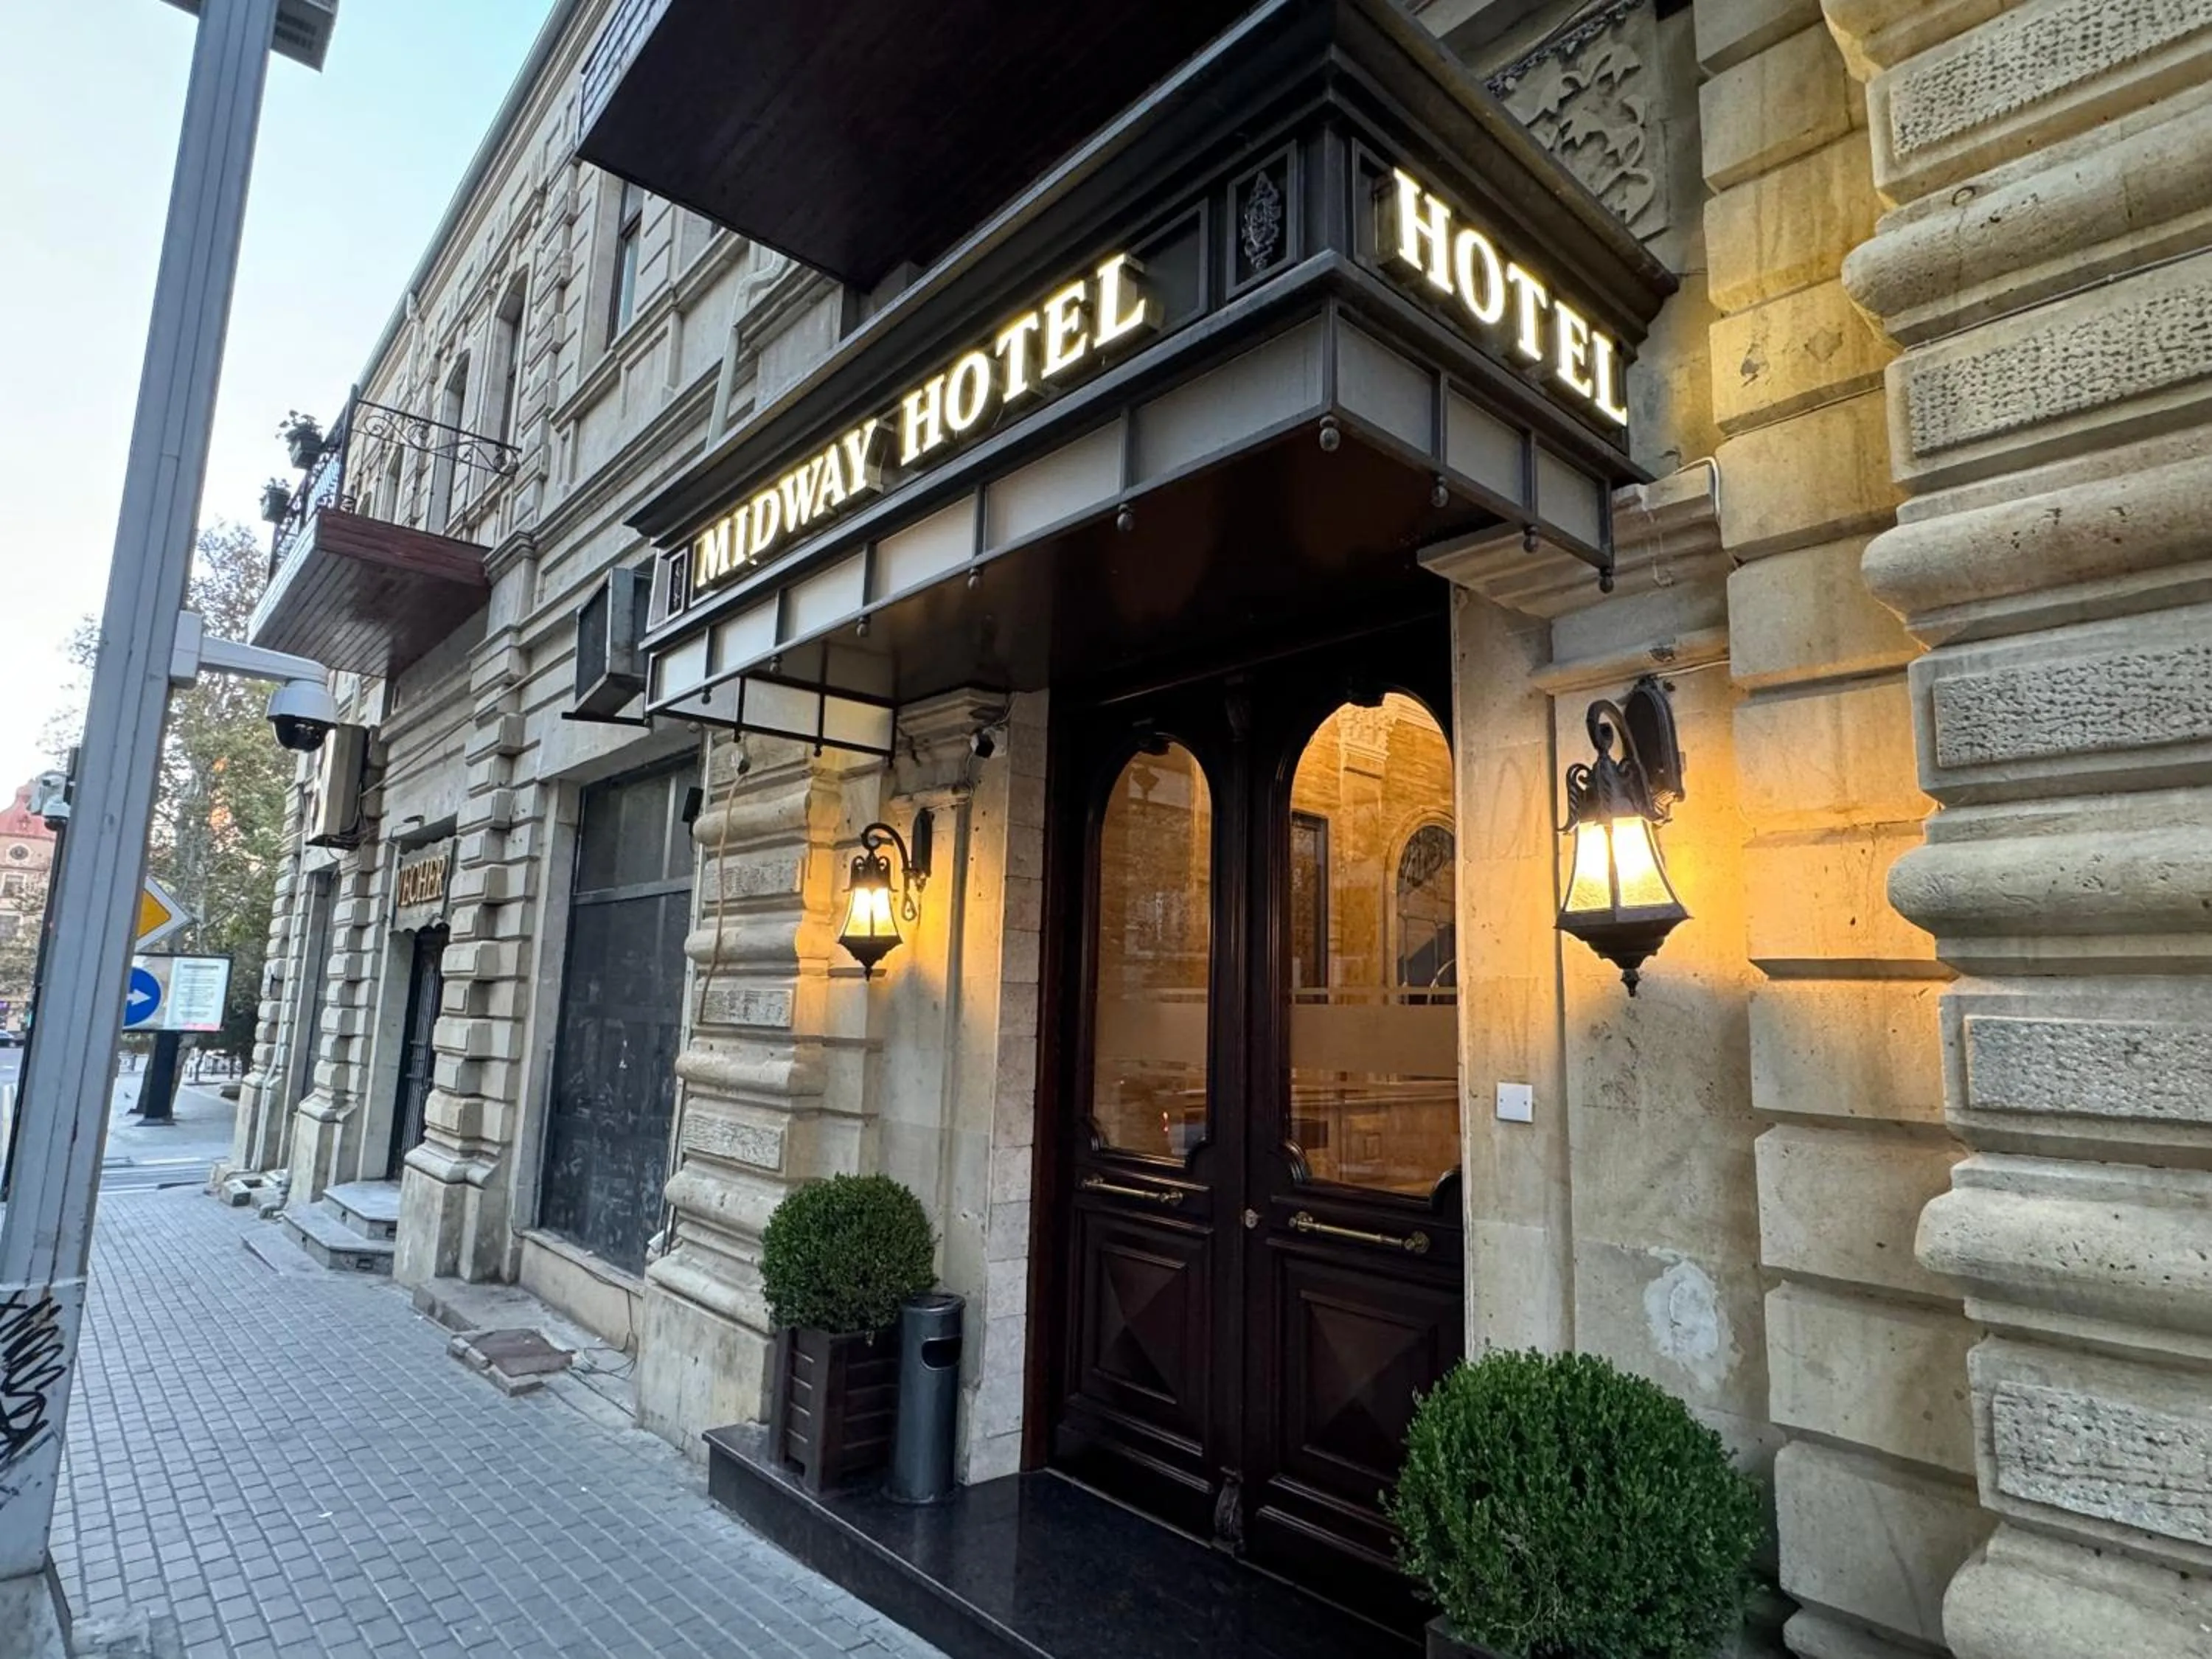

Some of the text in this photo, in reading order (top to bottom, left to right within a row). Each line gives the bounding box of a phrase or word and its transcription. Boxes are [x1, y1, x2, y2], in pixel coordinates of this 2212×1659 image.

[695, 251, 1147, 588] MIDWAY HOTEL
[1393, 167, 1627, 426] HOTEL
